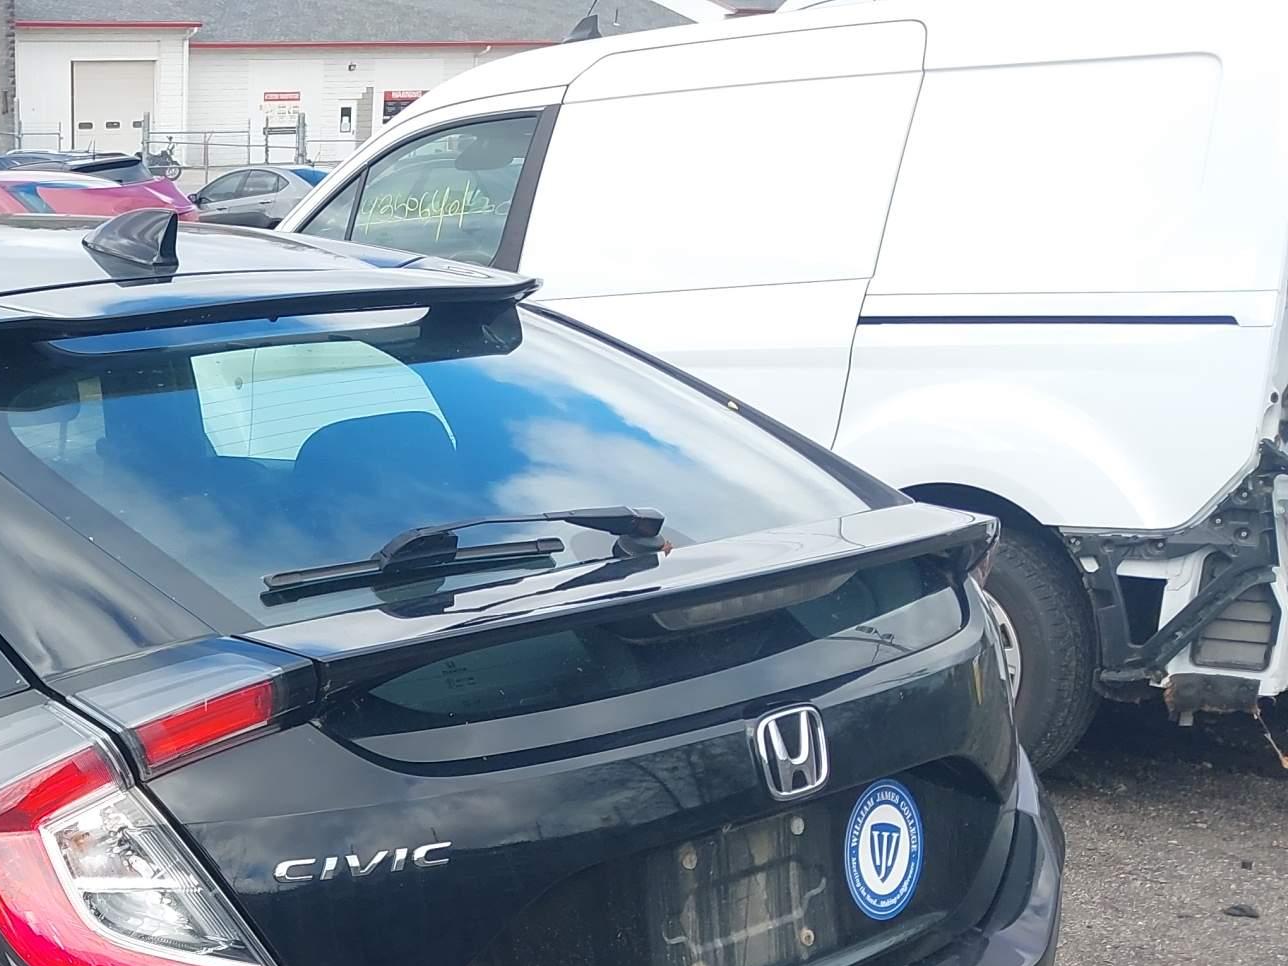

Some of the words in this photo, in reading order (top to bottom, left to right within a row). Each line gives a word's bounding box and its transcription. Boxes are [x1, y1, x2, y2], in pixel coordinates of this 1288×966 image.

[851, 797, 875, 847] WILLIAM
[876, 791, 900, 805] JAMES
[900, 800, 918, 853] COLLEGE
[273, 841, 453, 883] CIVIC
